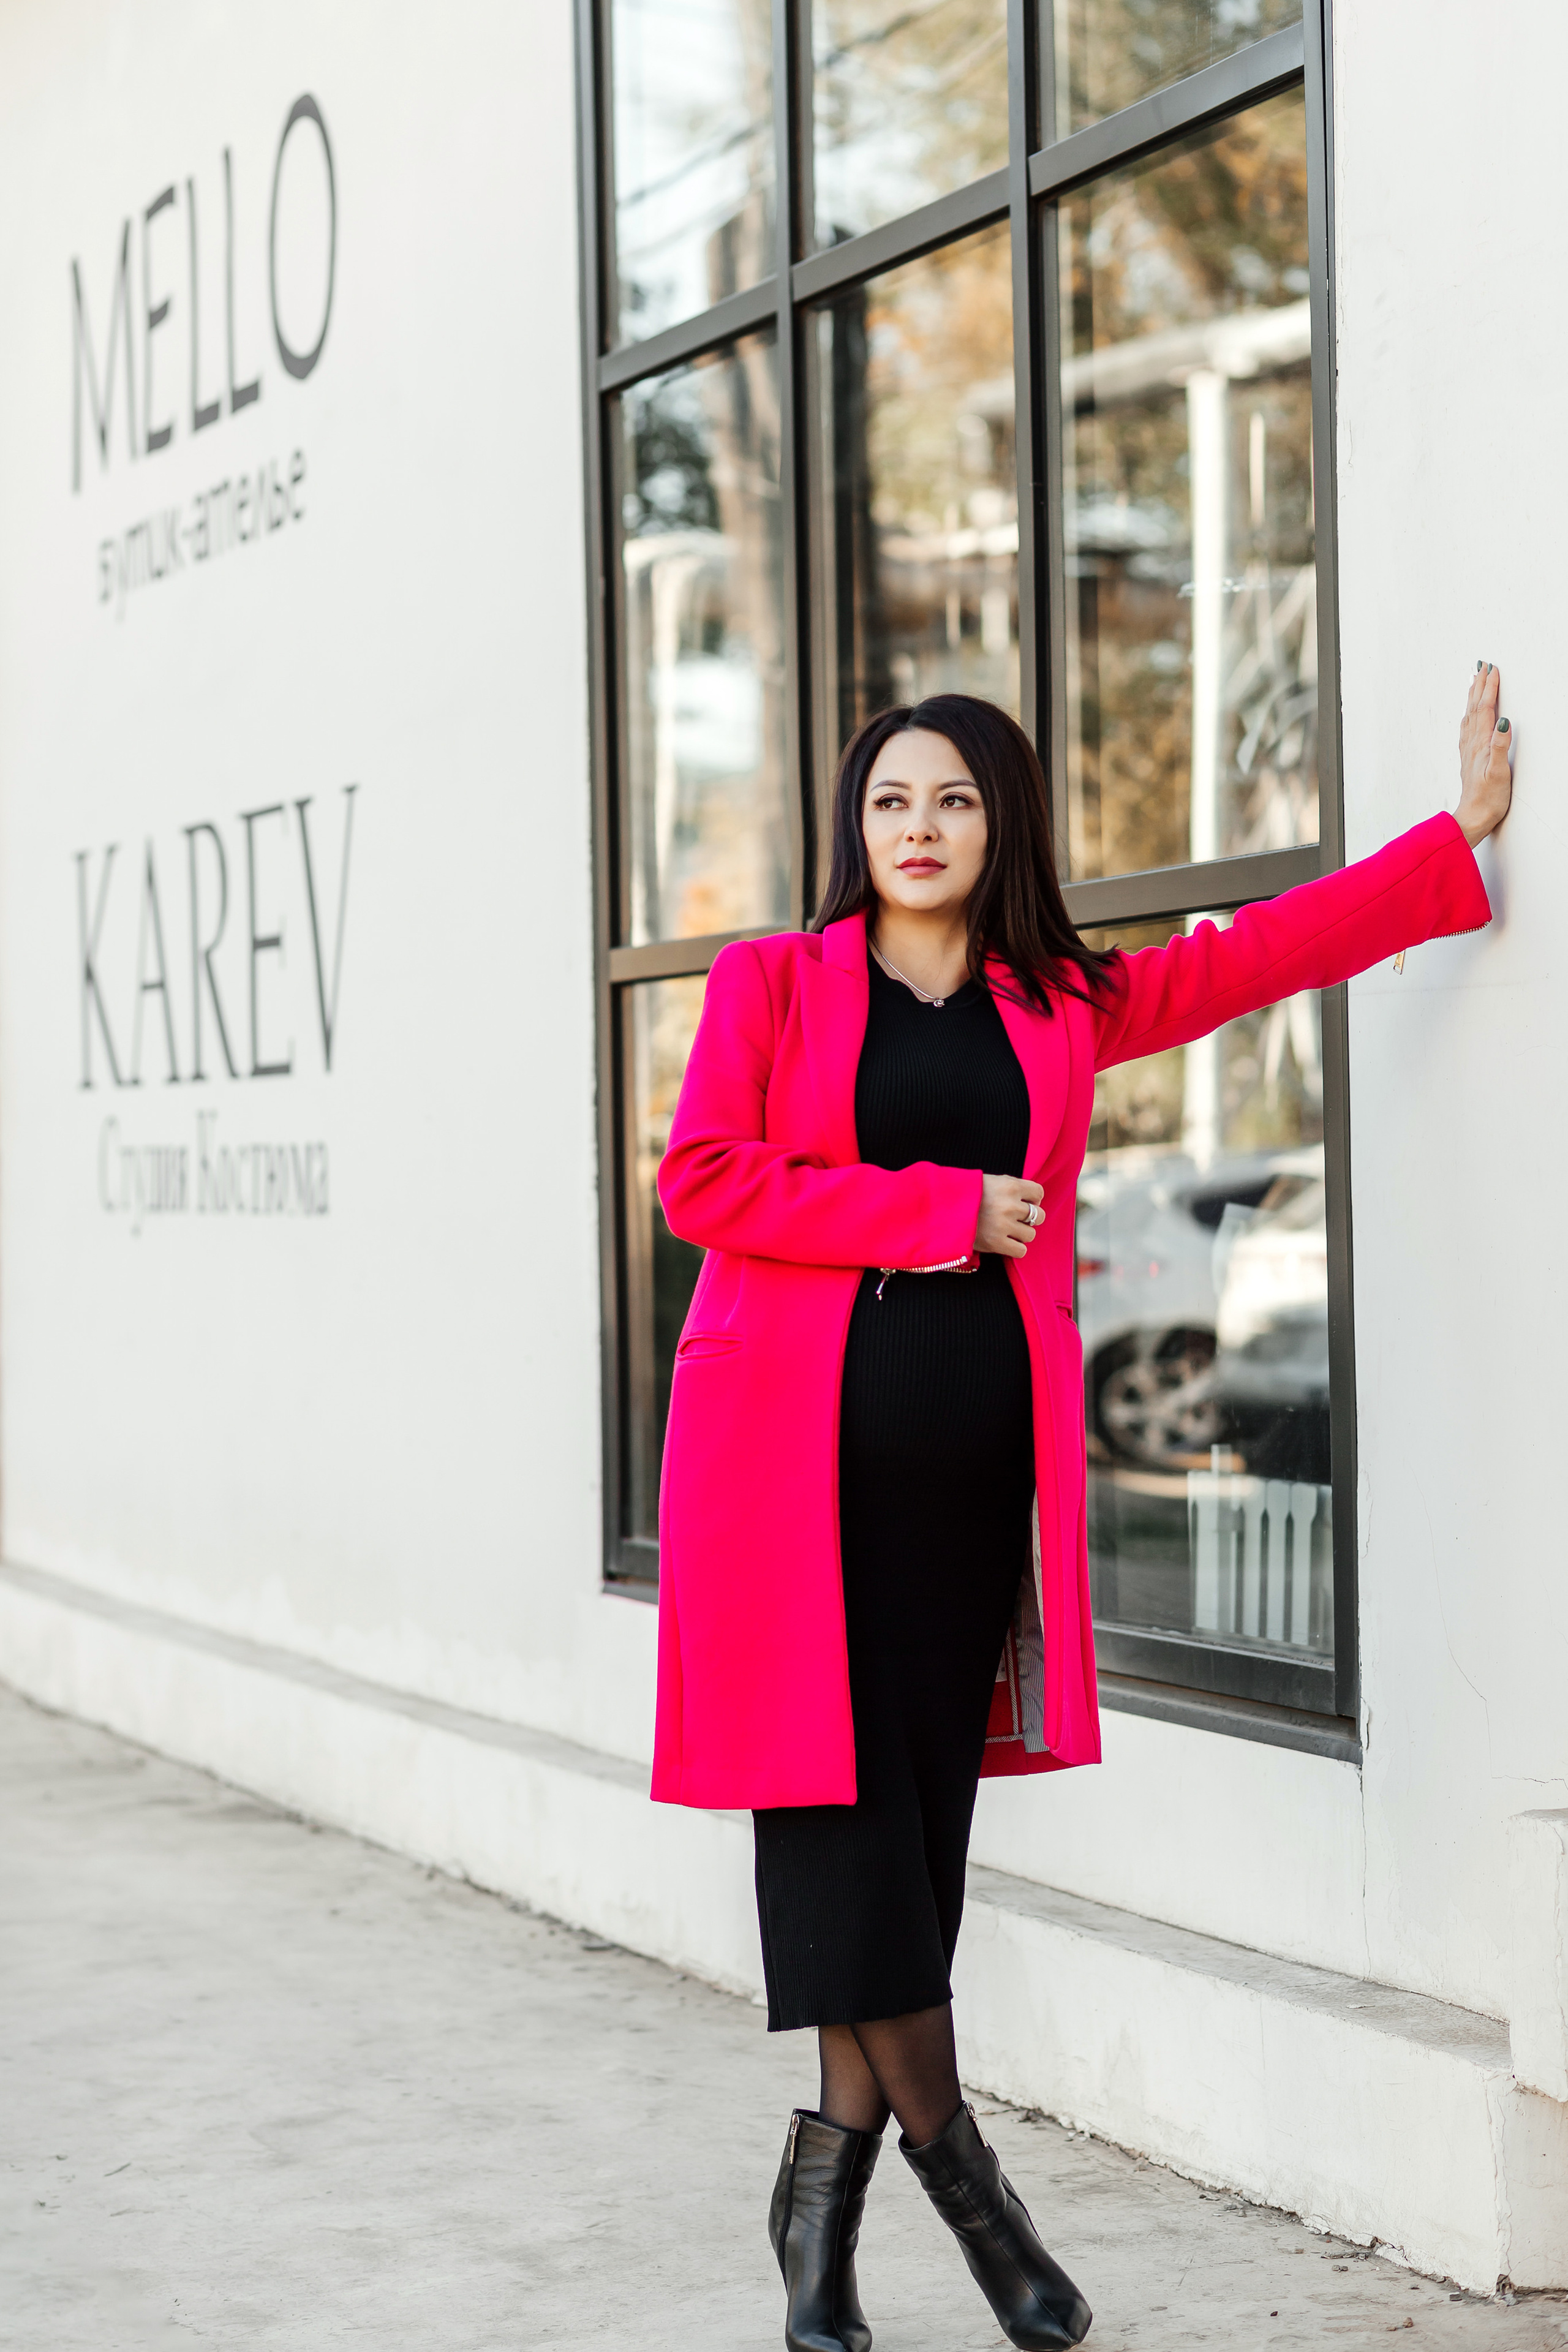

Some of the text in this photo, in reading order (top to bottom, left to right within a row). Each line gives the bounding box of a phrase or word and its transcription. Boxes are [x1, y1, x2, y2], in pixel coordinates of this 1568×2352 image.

[70, 91, 337, 494] MELLO
[74, 783, 358, 1091] KAREV
[196, 1110, 329, 1216] Костюма
